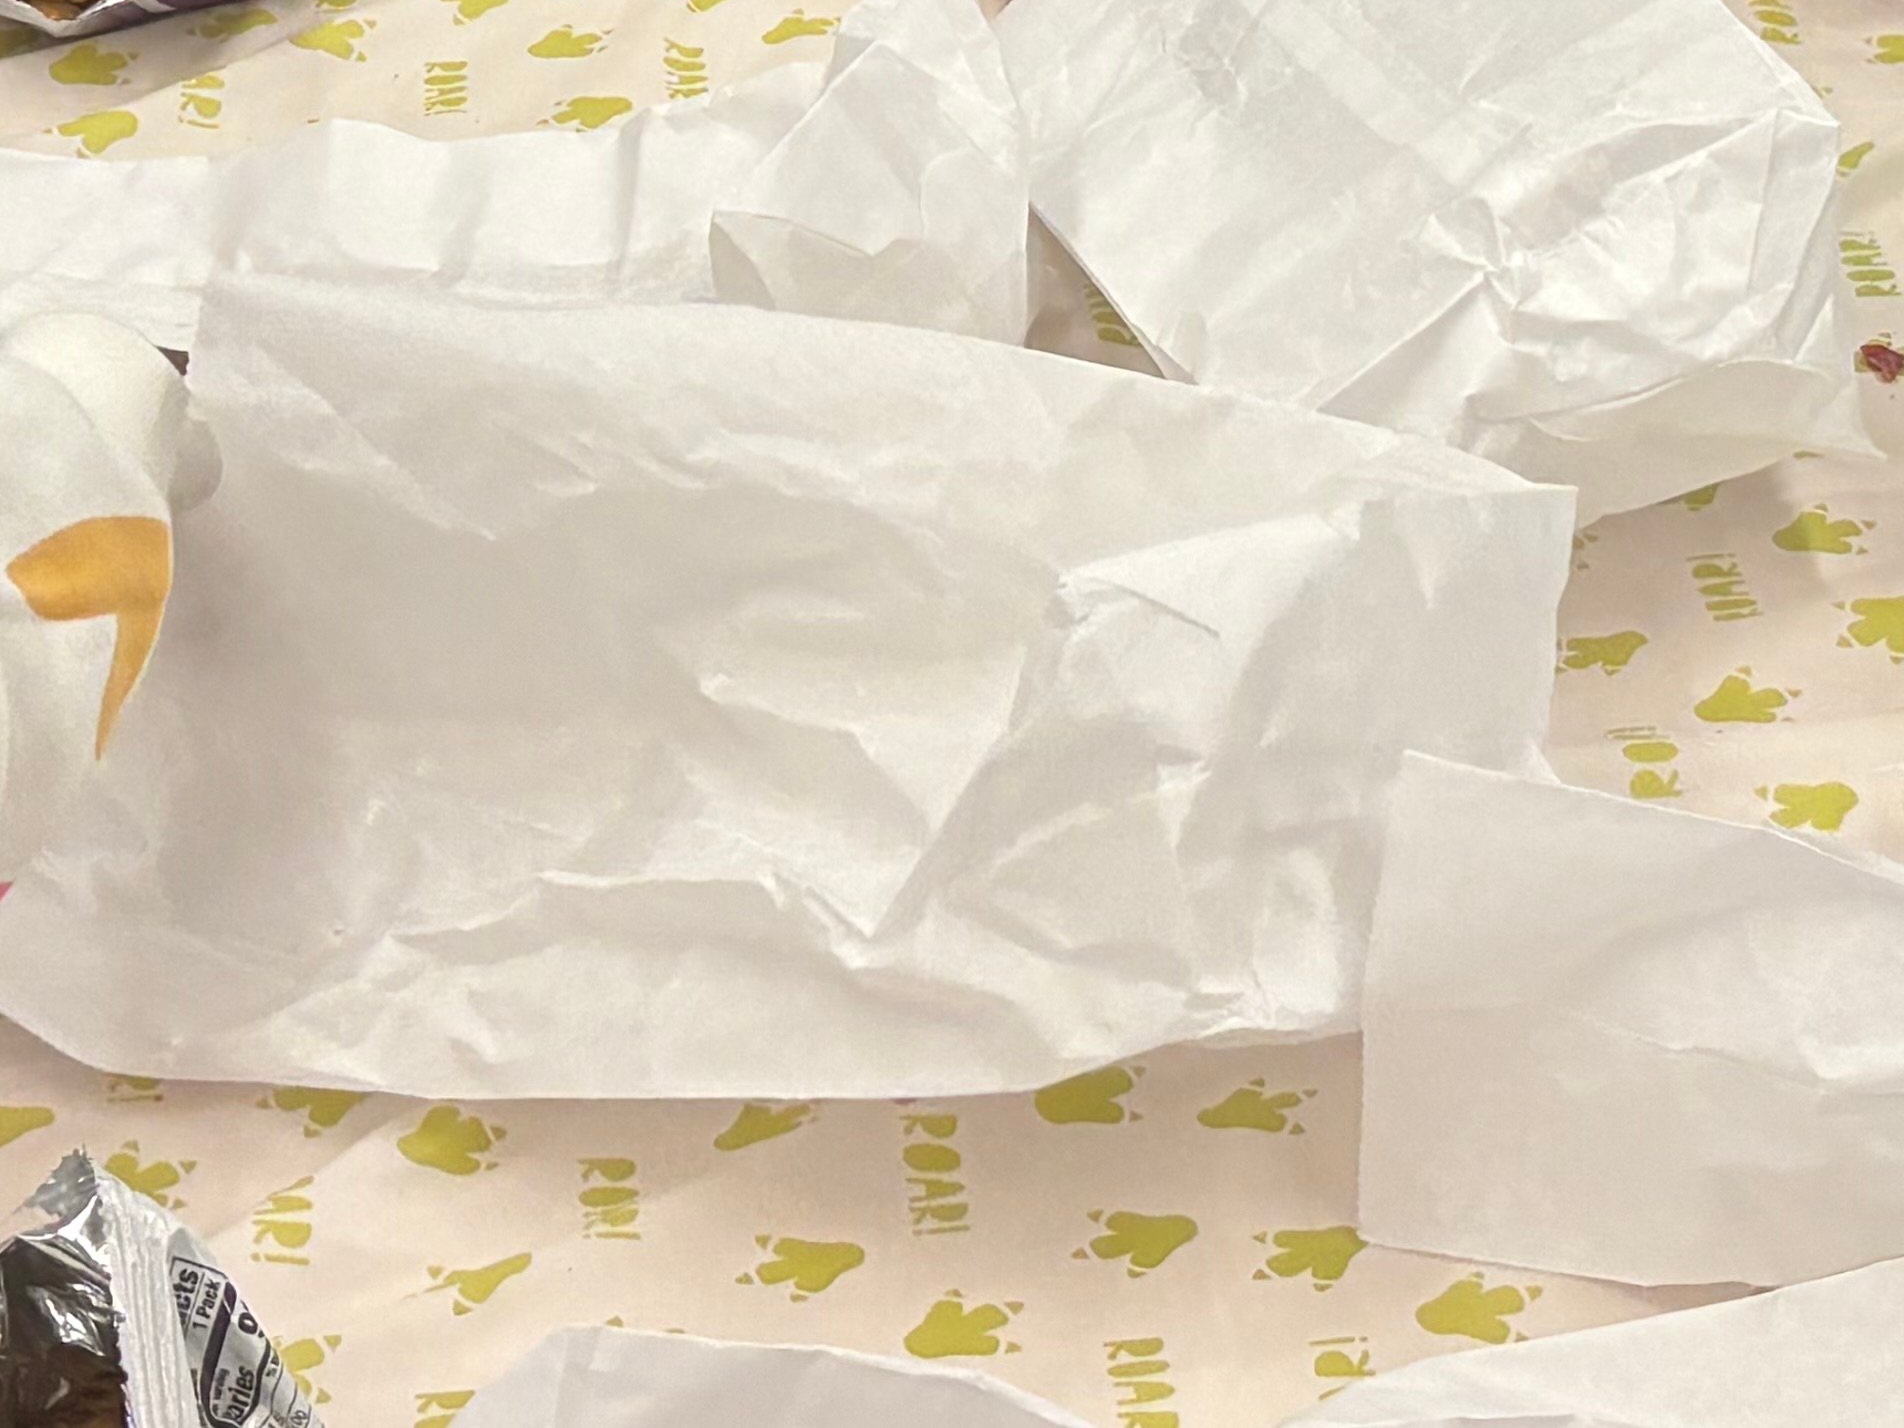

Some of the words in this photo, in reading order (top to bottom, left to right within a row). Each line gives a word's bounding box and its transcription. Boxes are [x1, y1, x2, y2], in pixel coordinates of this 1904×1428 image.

[900, 1110, 972, 1239] ROAR!
[195, 1277, 222, 1320] Pack
[1105, 1335, 1183, 1428] ROAR
